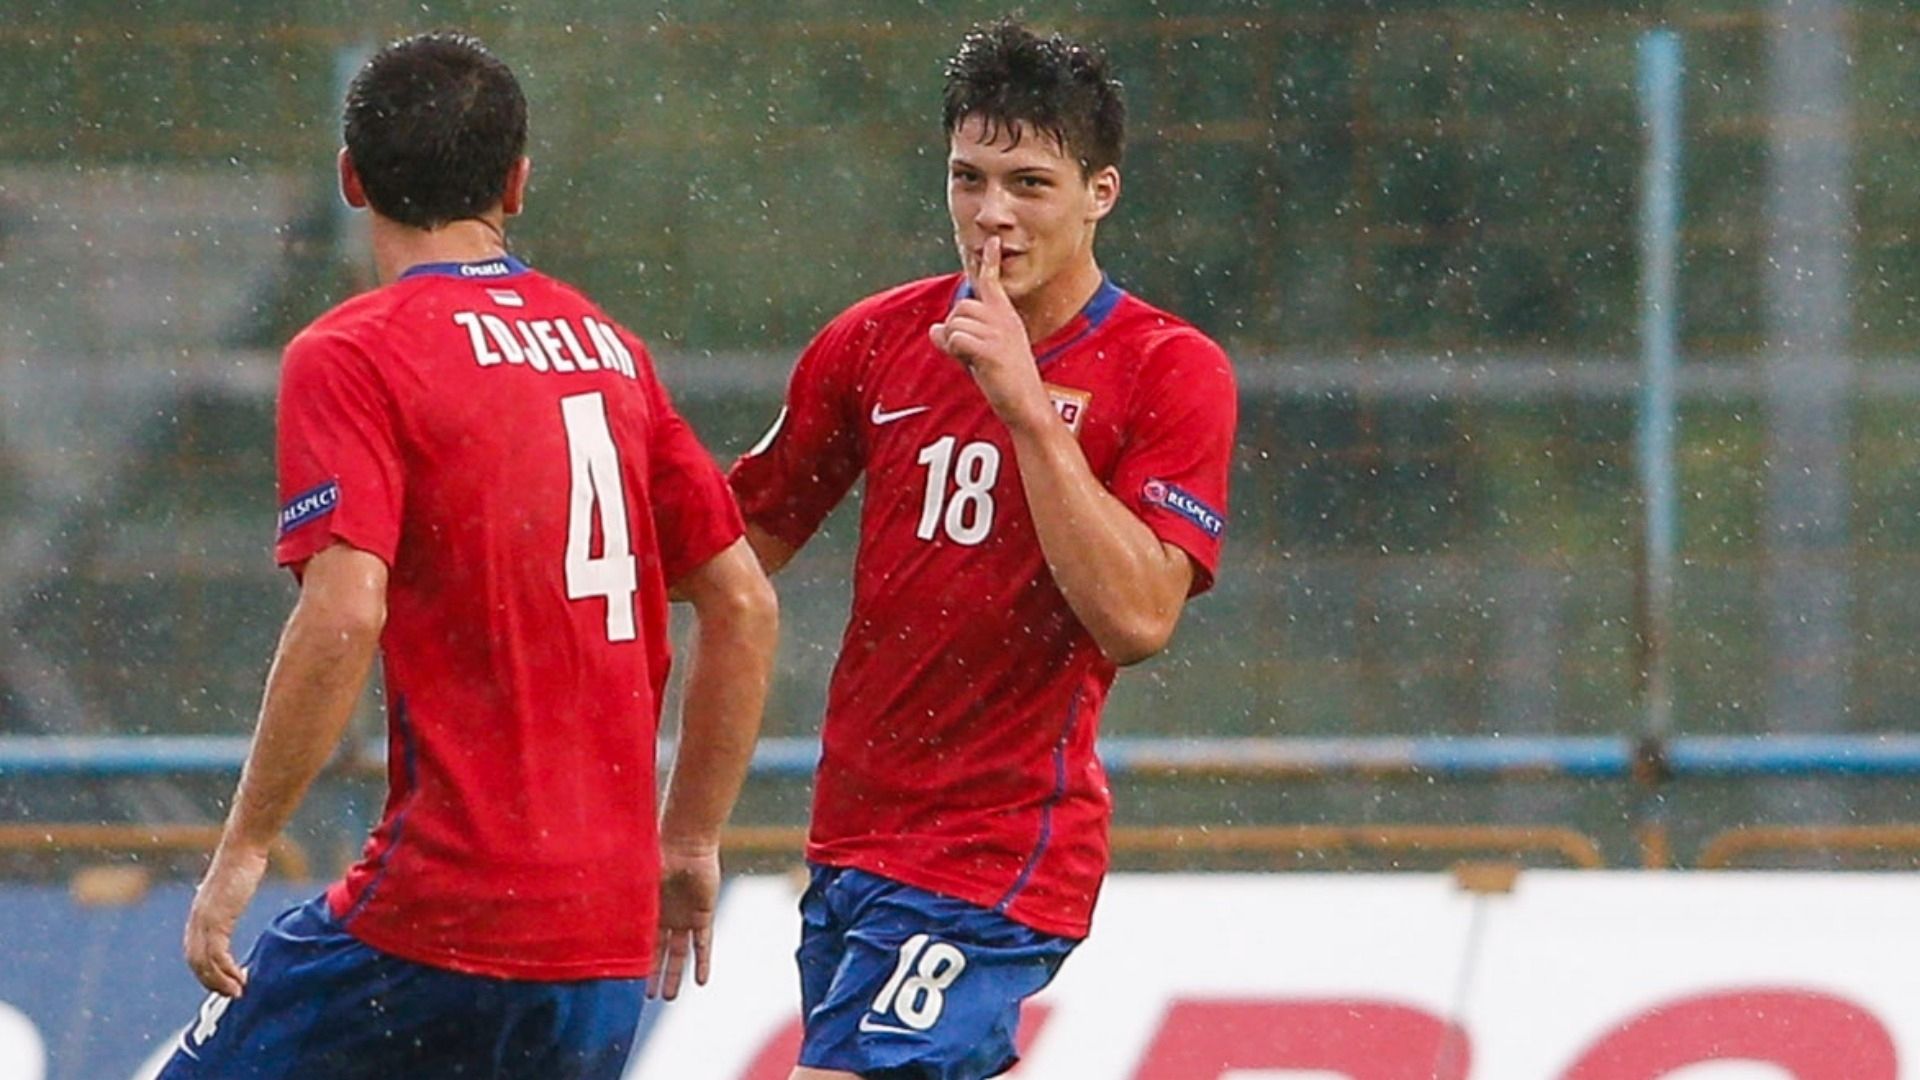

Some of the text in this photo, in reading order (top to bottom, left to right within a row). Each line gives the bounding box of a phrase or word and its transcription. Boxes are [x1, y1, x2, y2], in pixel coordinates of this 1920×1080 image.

[561, 391, 638, 642] 4
[916, 435, 1000, 546] 18
[1167, 492, 1222, 533] RESPECT
[872, 933, 966, 1030] 18
